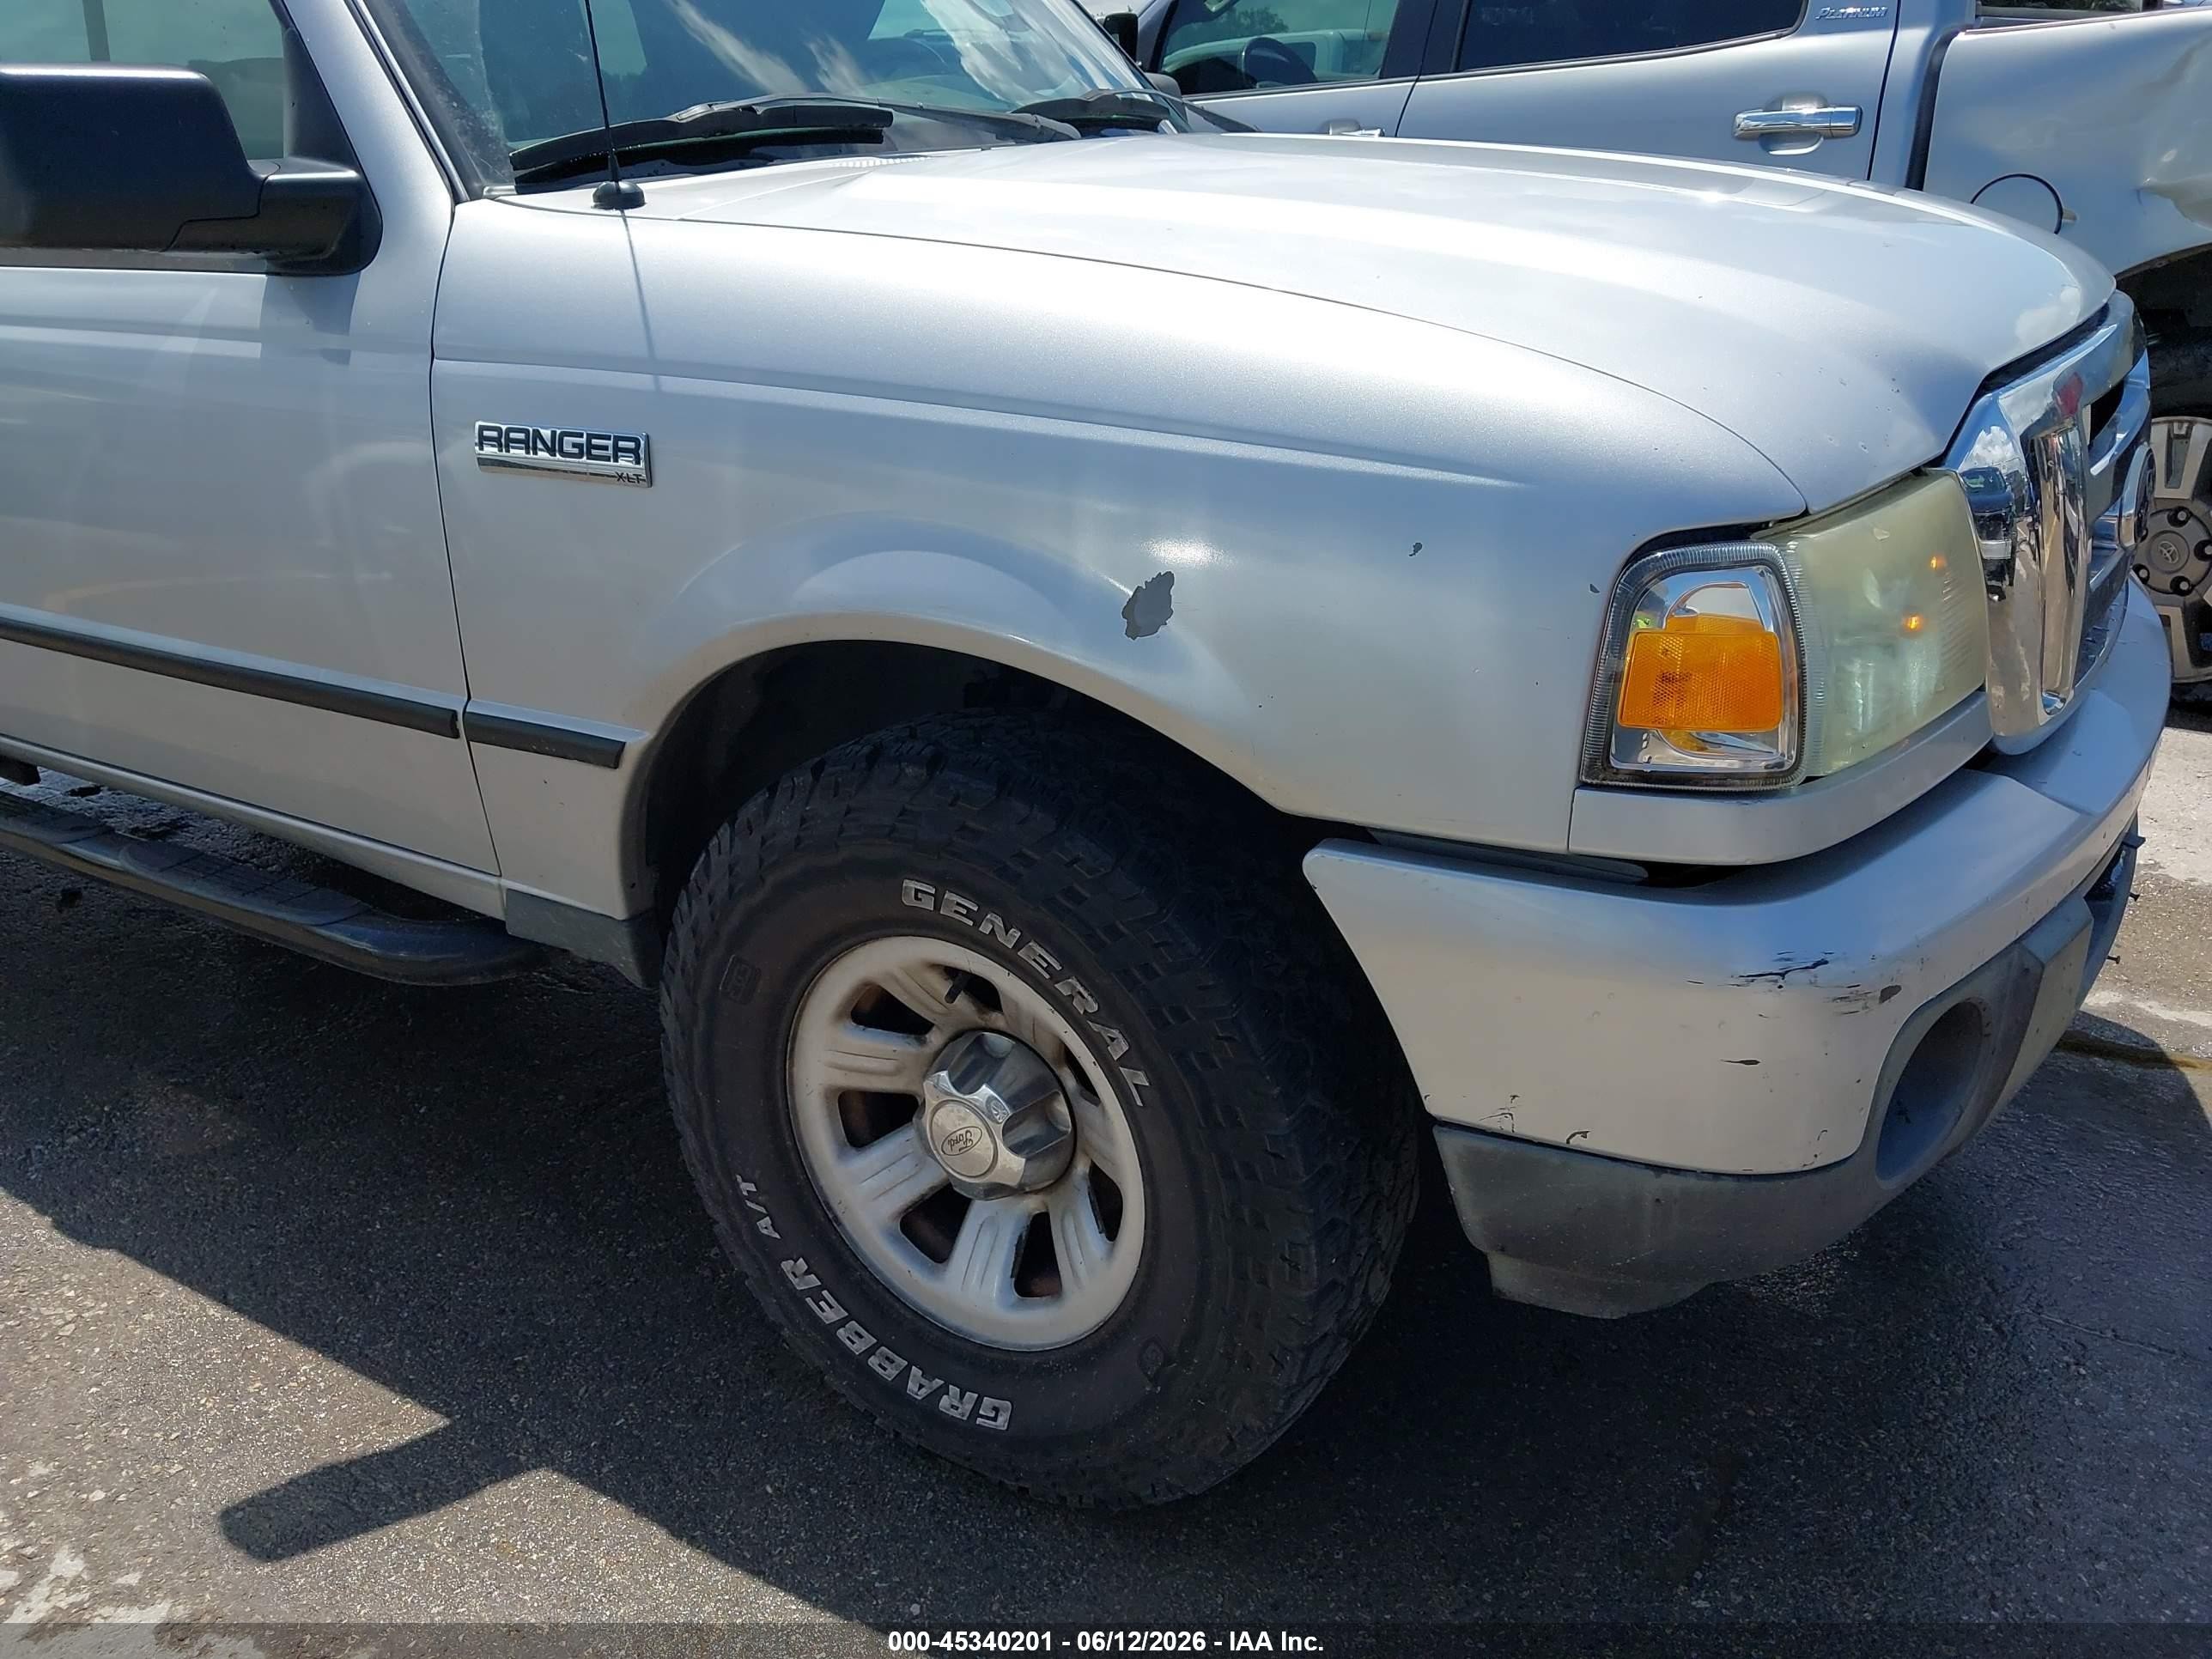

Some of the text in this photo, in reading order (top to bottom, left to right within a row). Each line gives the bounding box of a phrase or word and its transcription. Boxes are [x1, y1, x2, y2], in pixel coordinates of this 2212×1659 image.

[477, 423, 641, 465] RANGER
[615, 471, 643, 484] XLT
[901, 878, 1151, 1107] GENERAL
[735, 1174, 1013, 1431] GRABBER A/T
